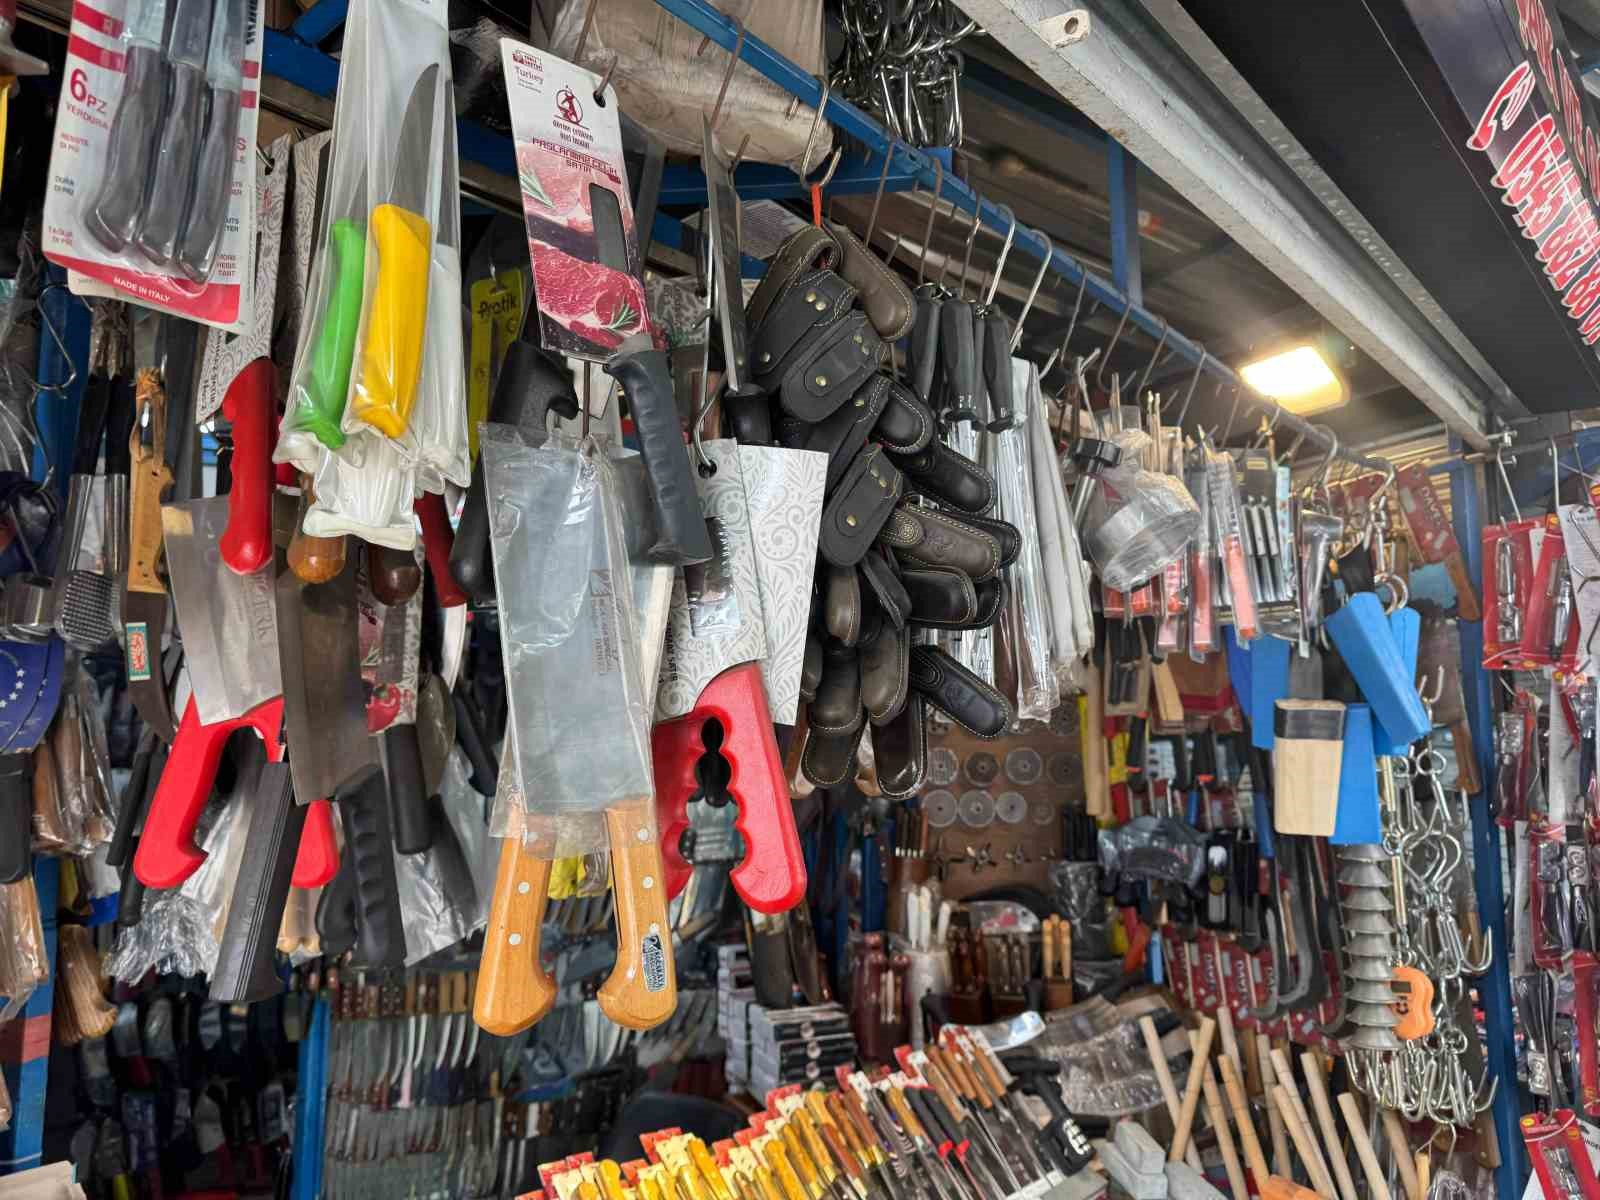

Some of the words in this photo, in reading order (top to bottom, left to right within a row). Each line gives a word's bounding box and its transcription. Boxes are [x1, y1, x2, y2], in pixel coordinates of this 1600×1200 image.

[1490, 112, 1582, 239] 0545
[113, 275, 138, 291] MADE
[148, 288, 171, 304] ITALY
